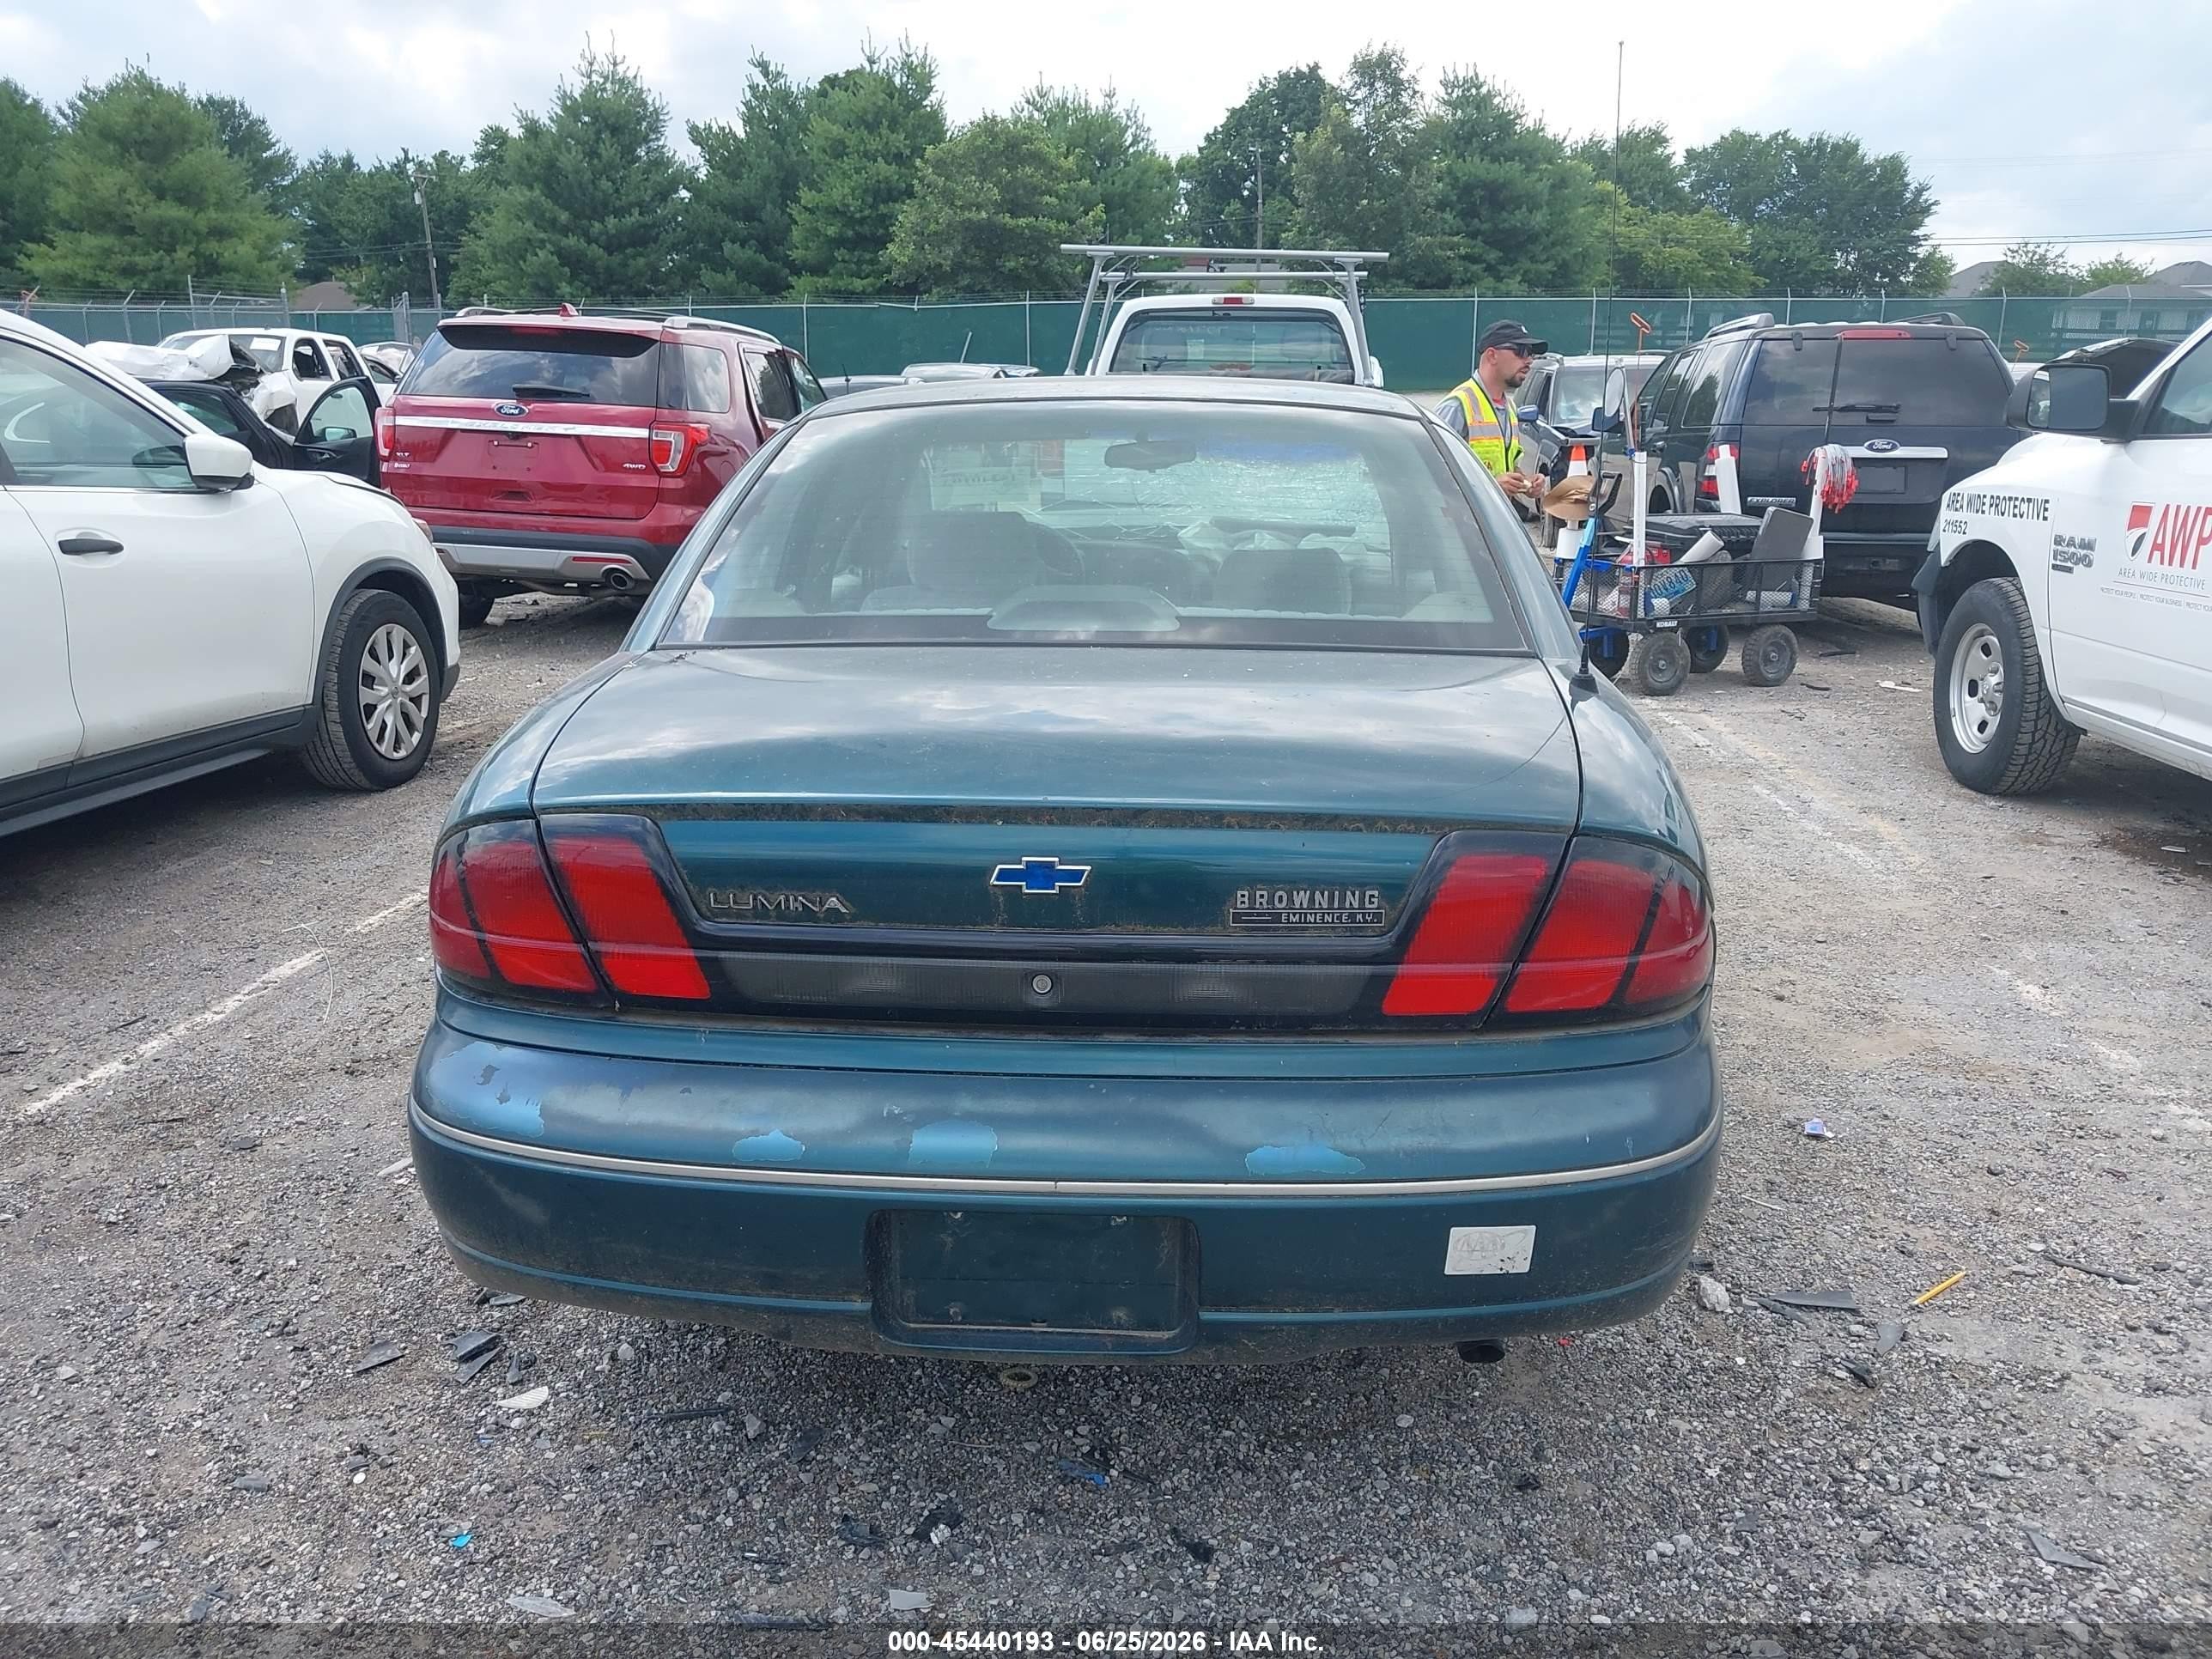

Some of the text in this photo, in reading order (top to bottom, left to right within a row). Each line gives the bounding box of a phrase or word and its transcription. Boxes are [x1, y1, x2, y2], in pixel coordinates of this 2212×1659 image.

[501, 404, 520, 415] Ford
[1872, 441, 1892, 451] Ford
[1946, 491, 2050, 521] AREA WIDE PROTECTIVE
[1942, 519, 1968, 535] 211552
[2053, 534, 2097, 552] RAM
[2052, 549, 2094, 568] 1500
[2118, 568, 2206, 591] AREA WIDE PROTECTIVE
[709, 892, 849, 913] LUMINA
[1237, 890, 1379, 908] BROWNING
[1356, 913, 1377, 923] KY.
